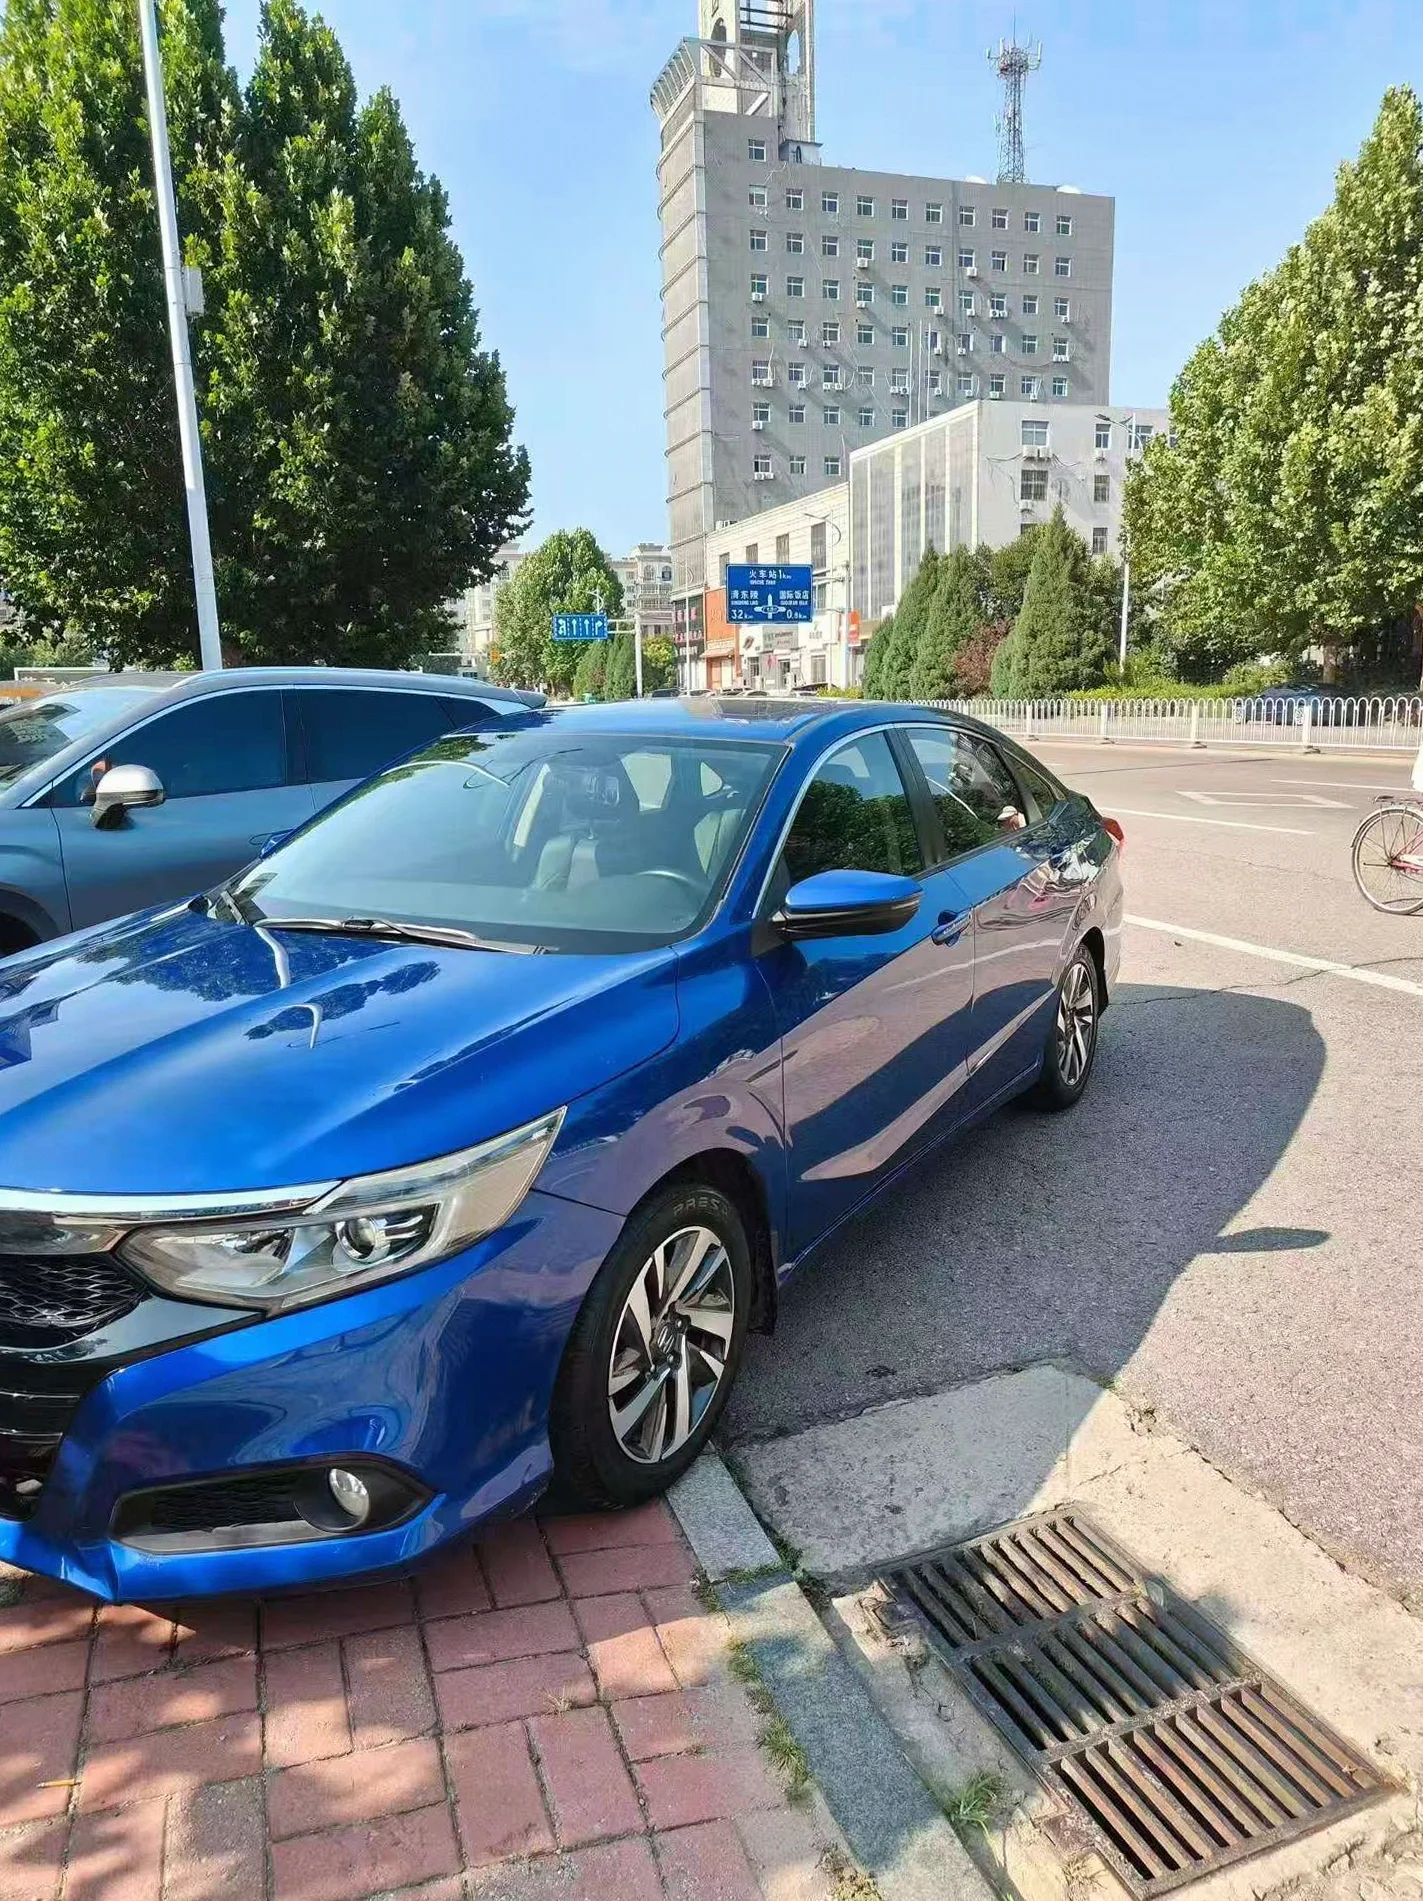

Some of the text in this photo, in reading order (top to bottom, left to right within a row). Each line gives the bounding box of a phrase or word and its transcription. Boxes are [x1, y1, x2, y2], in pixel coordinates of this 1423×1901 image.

[749, 569, 777, 580] 火车站
[779, 590, 809, 600] 国际饭店
